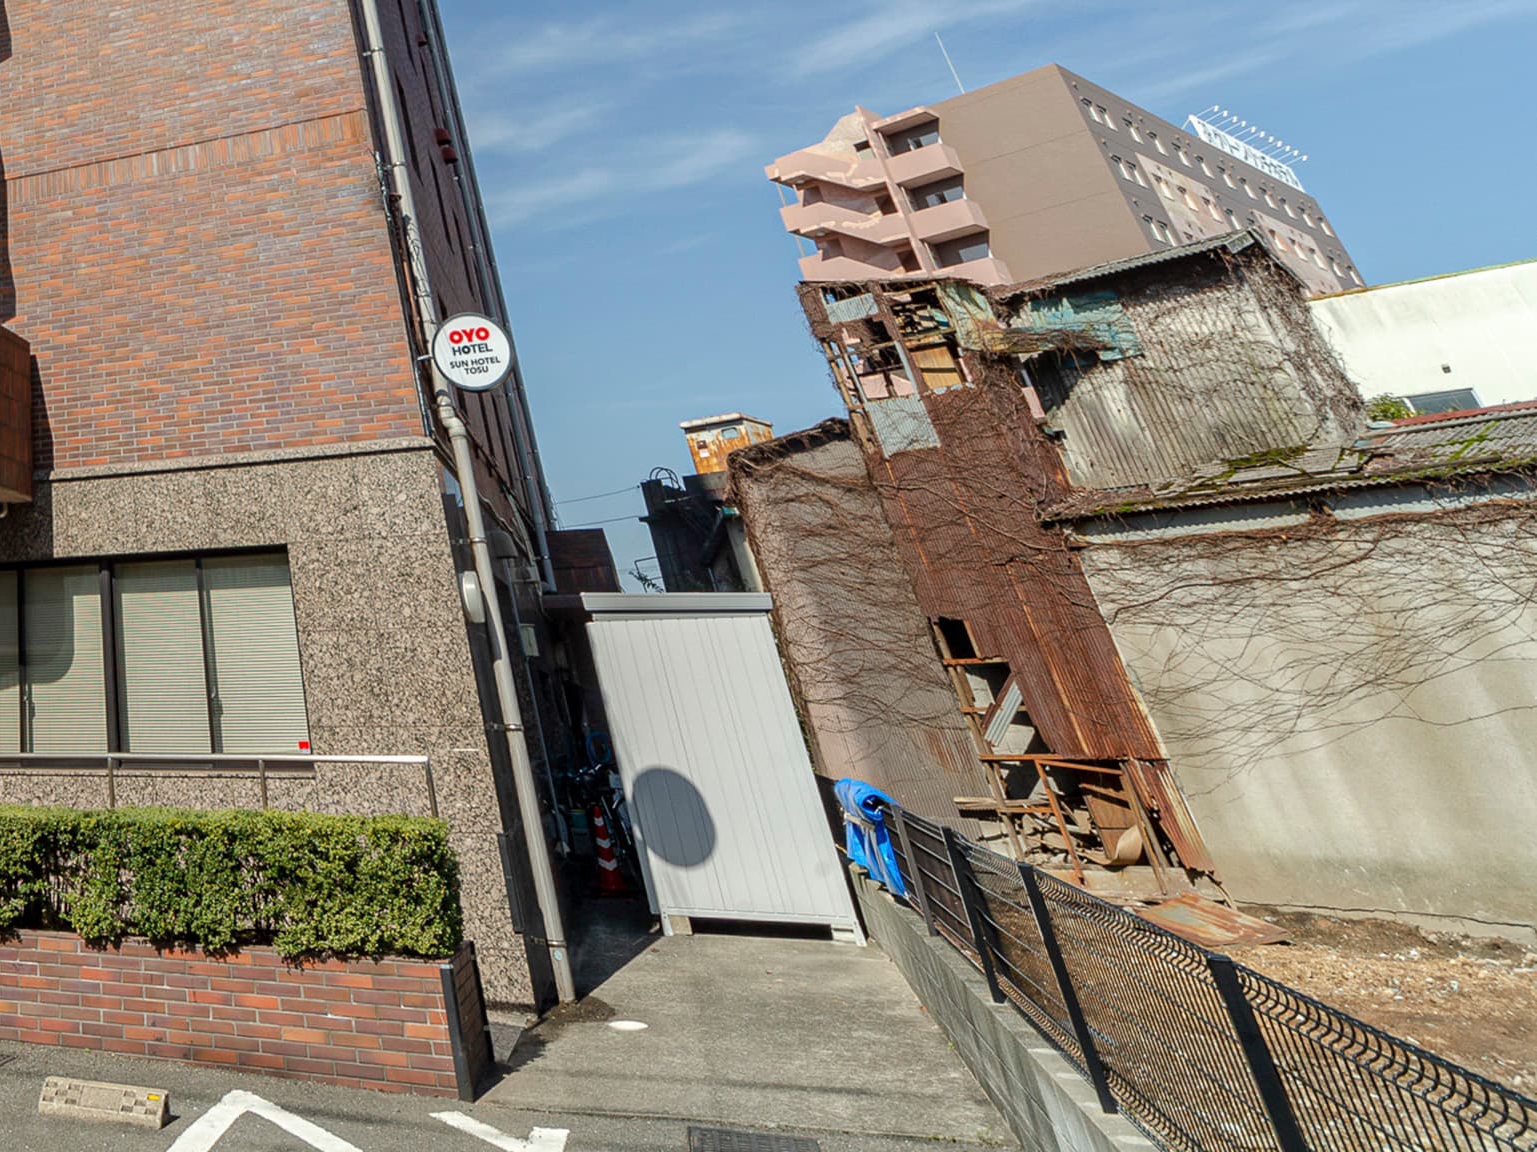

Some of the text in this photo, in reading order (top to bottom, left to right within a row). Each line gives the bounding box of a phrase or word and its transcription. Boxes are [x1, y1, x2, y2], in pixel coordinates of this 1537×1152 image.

[449, 327, 490, 344] OYO
[452, 343, 493, 356] HOTEL
[450, 356, 501, 369] SUN HOTEL
[464, 366, 489, 375] TOSU
